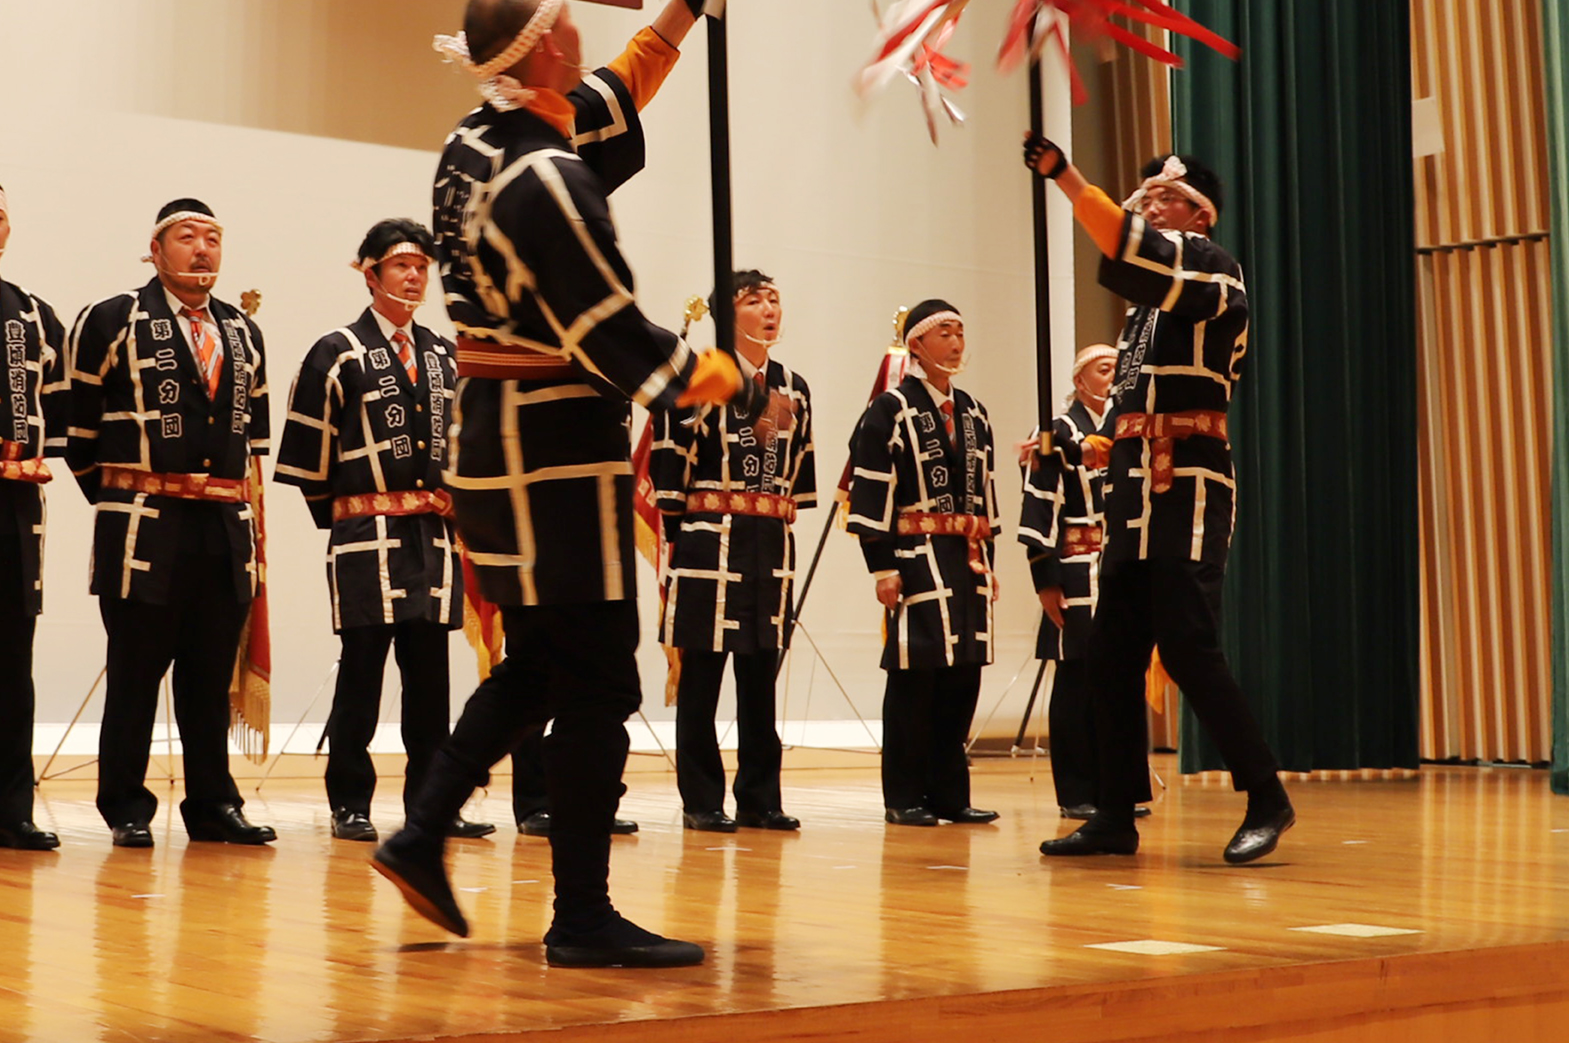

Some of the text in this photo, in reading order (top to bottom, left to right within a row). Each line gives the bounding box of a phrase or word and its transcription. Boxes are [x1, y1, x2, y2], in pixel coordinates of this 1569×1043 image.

[151, 319, 182, 438] 第二分団
[369, 347, 412, 459] 第二分団
